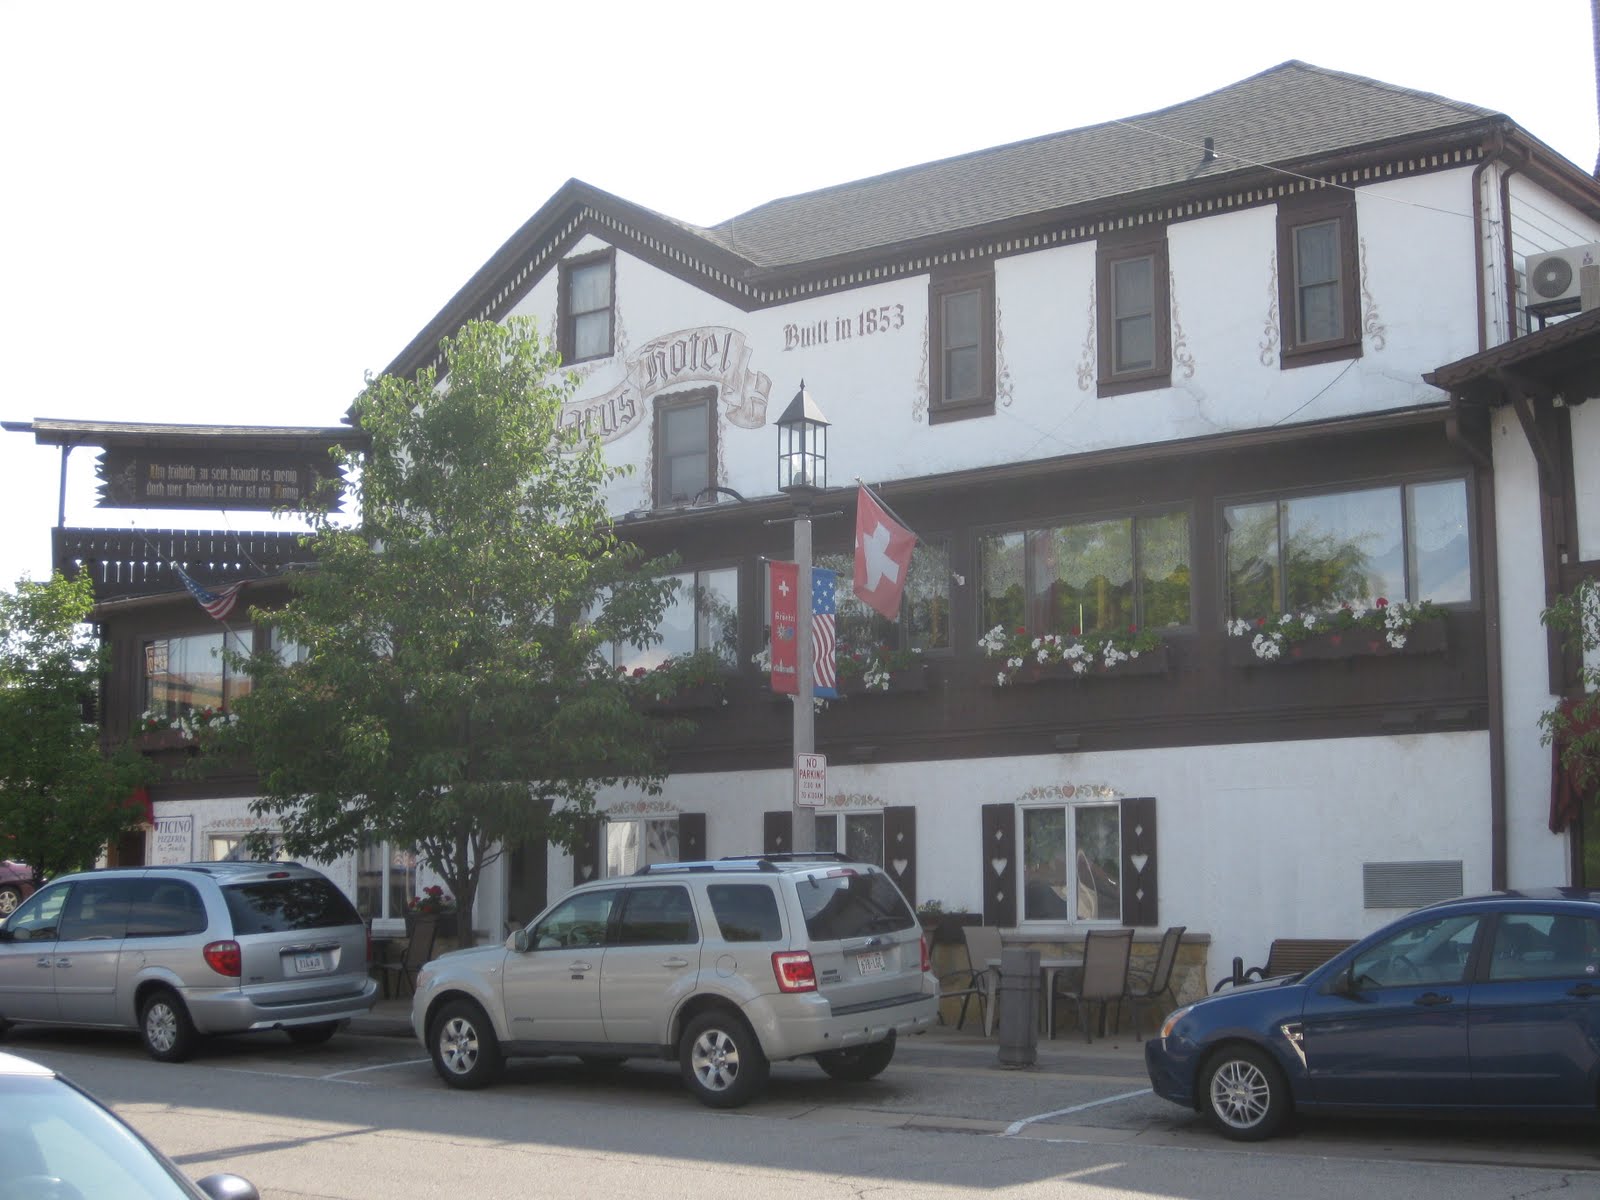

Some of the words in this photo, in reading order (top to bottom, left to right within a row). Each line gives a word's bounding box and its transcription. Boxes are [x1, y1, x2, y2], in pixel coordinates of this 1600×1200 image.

[836, 317, 851, 341] in
[857, 304, 904, 336] 1853
[556, 389, 635, 441] larus
[261, 469, 271, 482] es
[806, 758, 817, 768] NO
[799, 769, 825, 780] PARKING
[159, 820, 191, 833] TICINO
[157, 834, 186, 843] PIZZERIA
